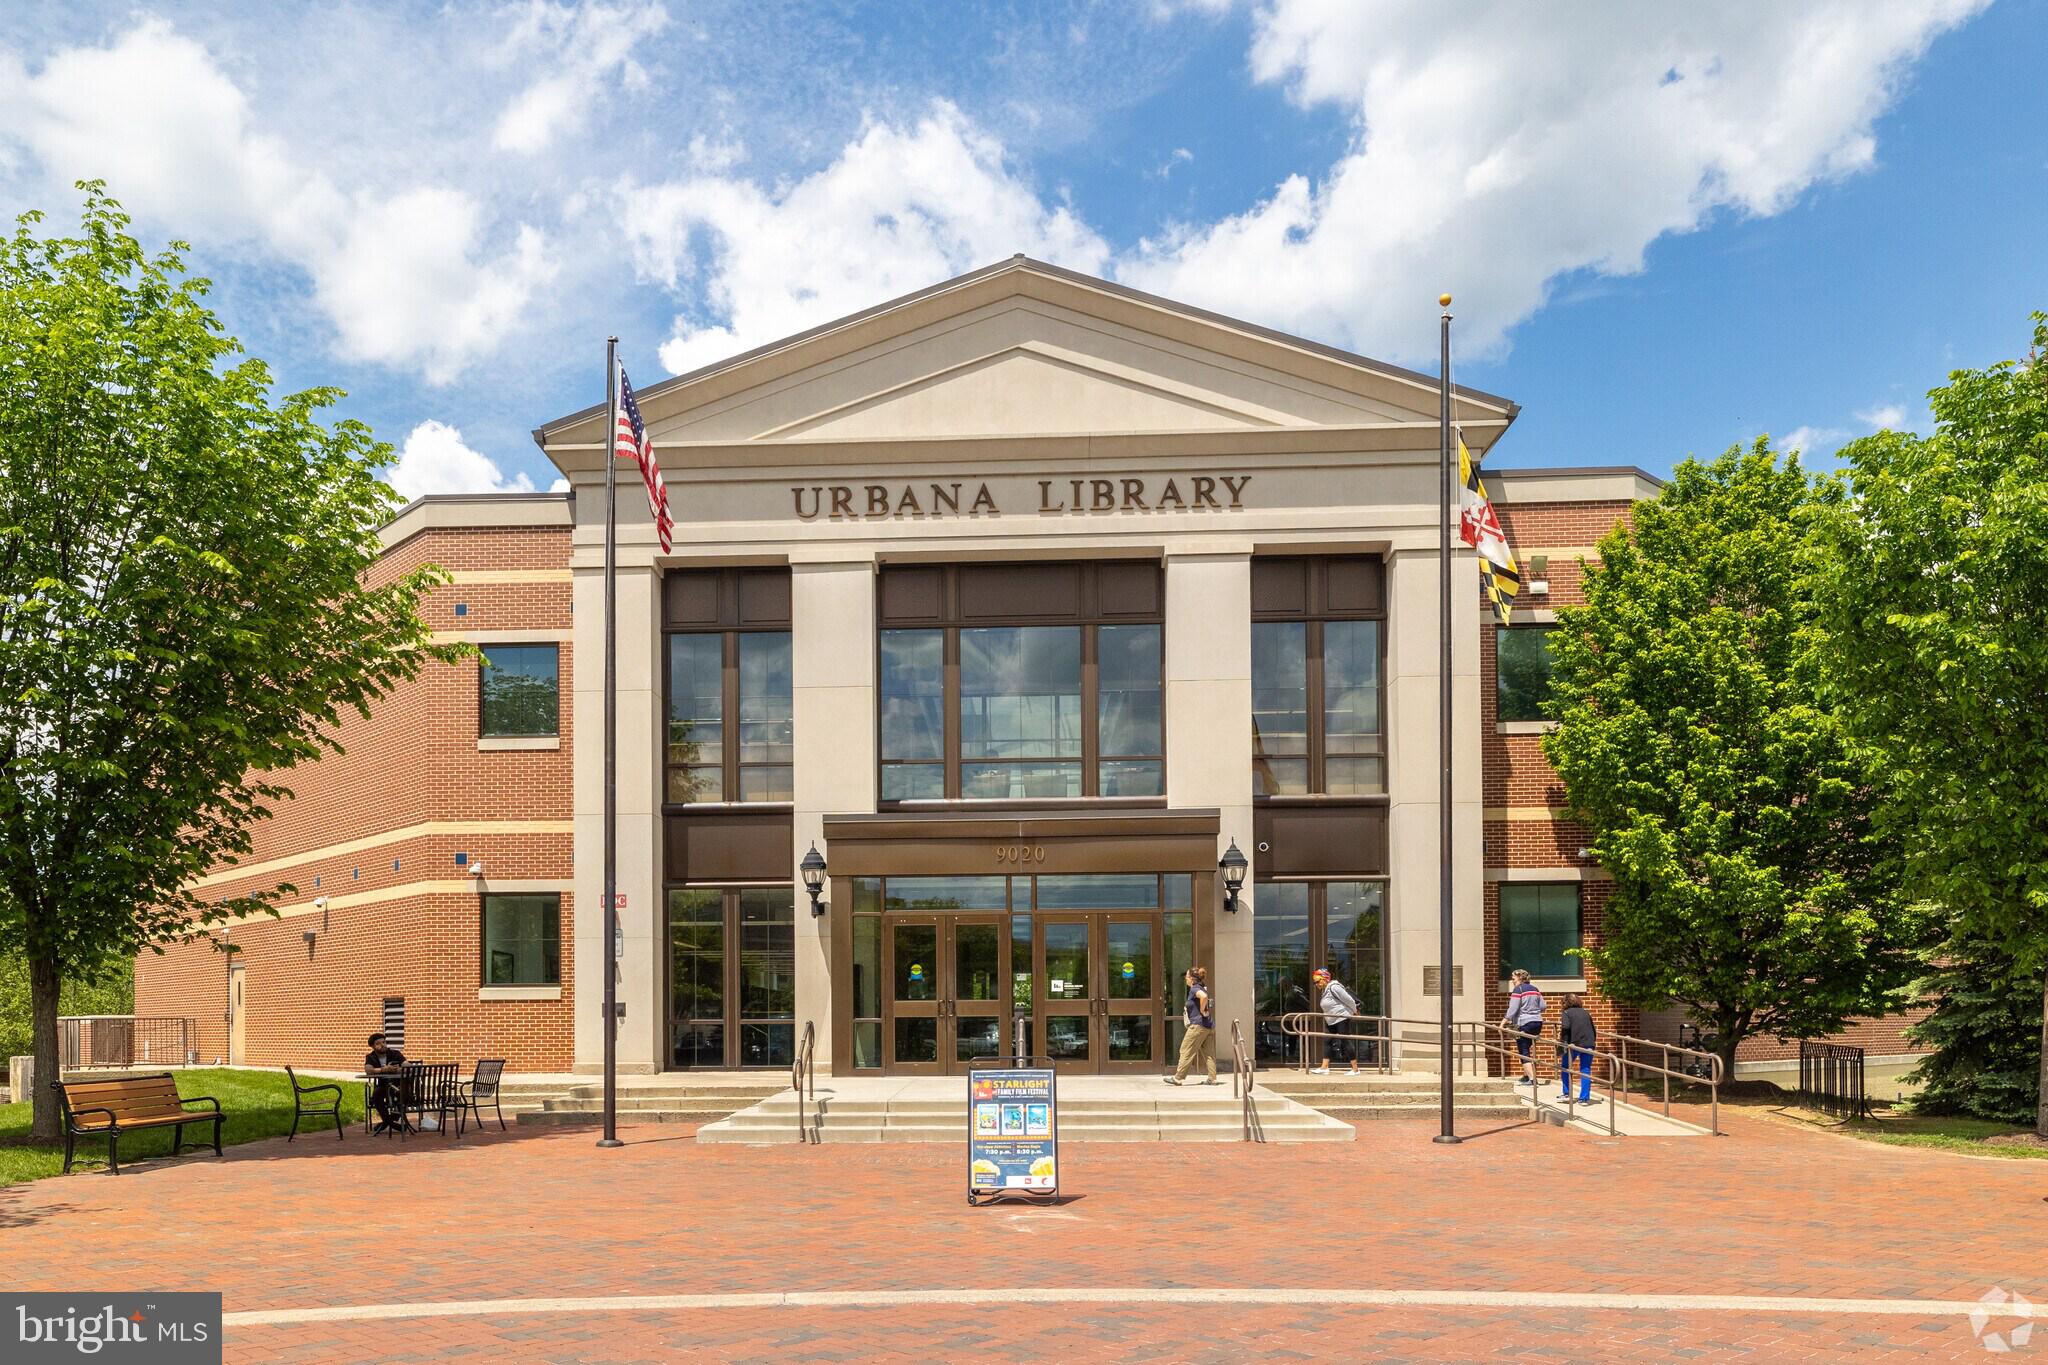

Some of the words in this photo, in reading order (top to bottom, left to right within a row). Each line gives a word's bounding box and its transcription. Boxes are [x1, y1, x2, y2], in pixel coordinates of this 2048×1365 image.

[791, 482, 1000, 518] URBANA
[1037, 476, 1252, 512] LIBRARY
[997, 846, 1045, 862] 9020
[993, 1080, 1049, 1089] STARLIGHT
